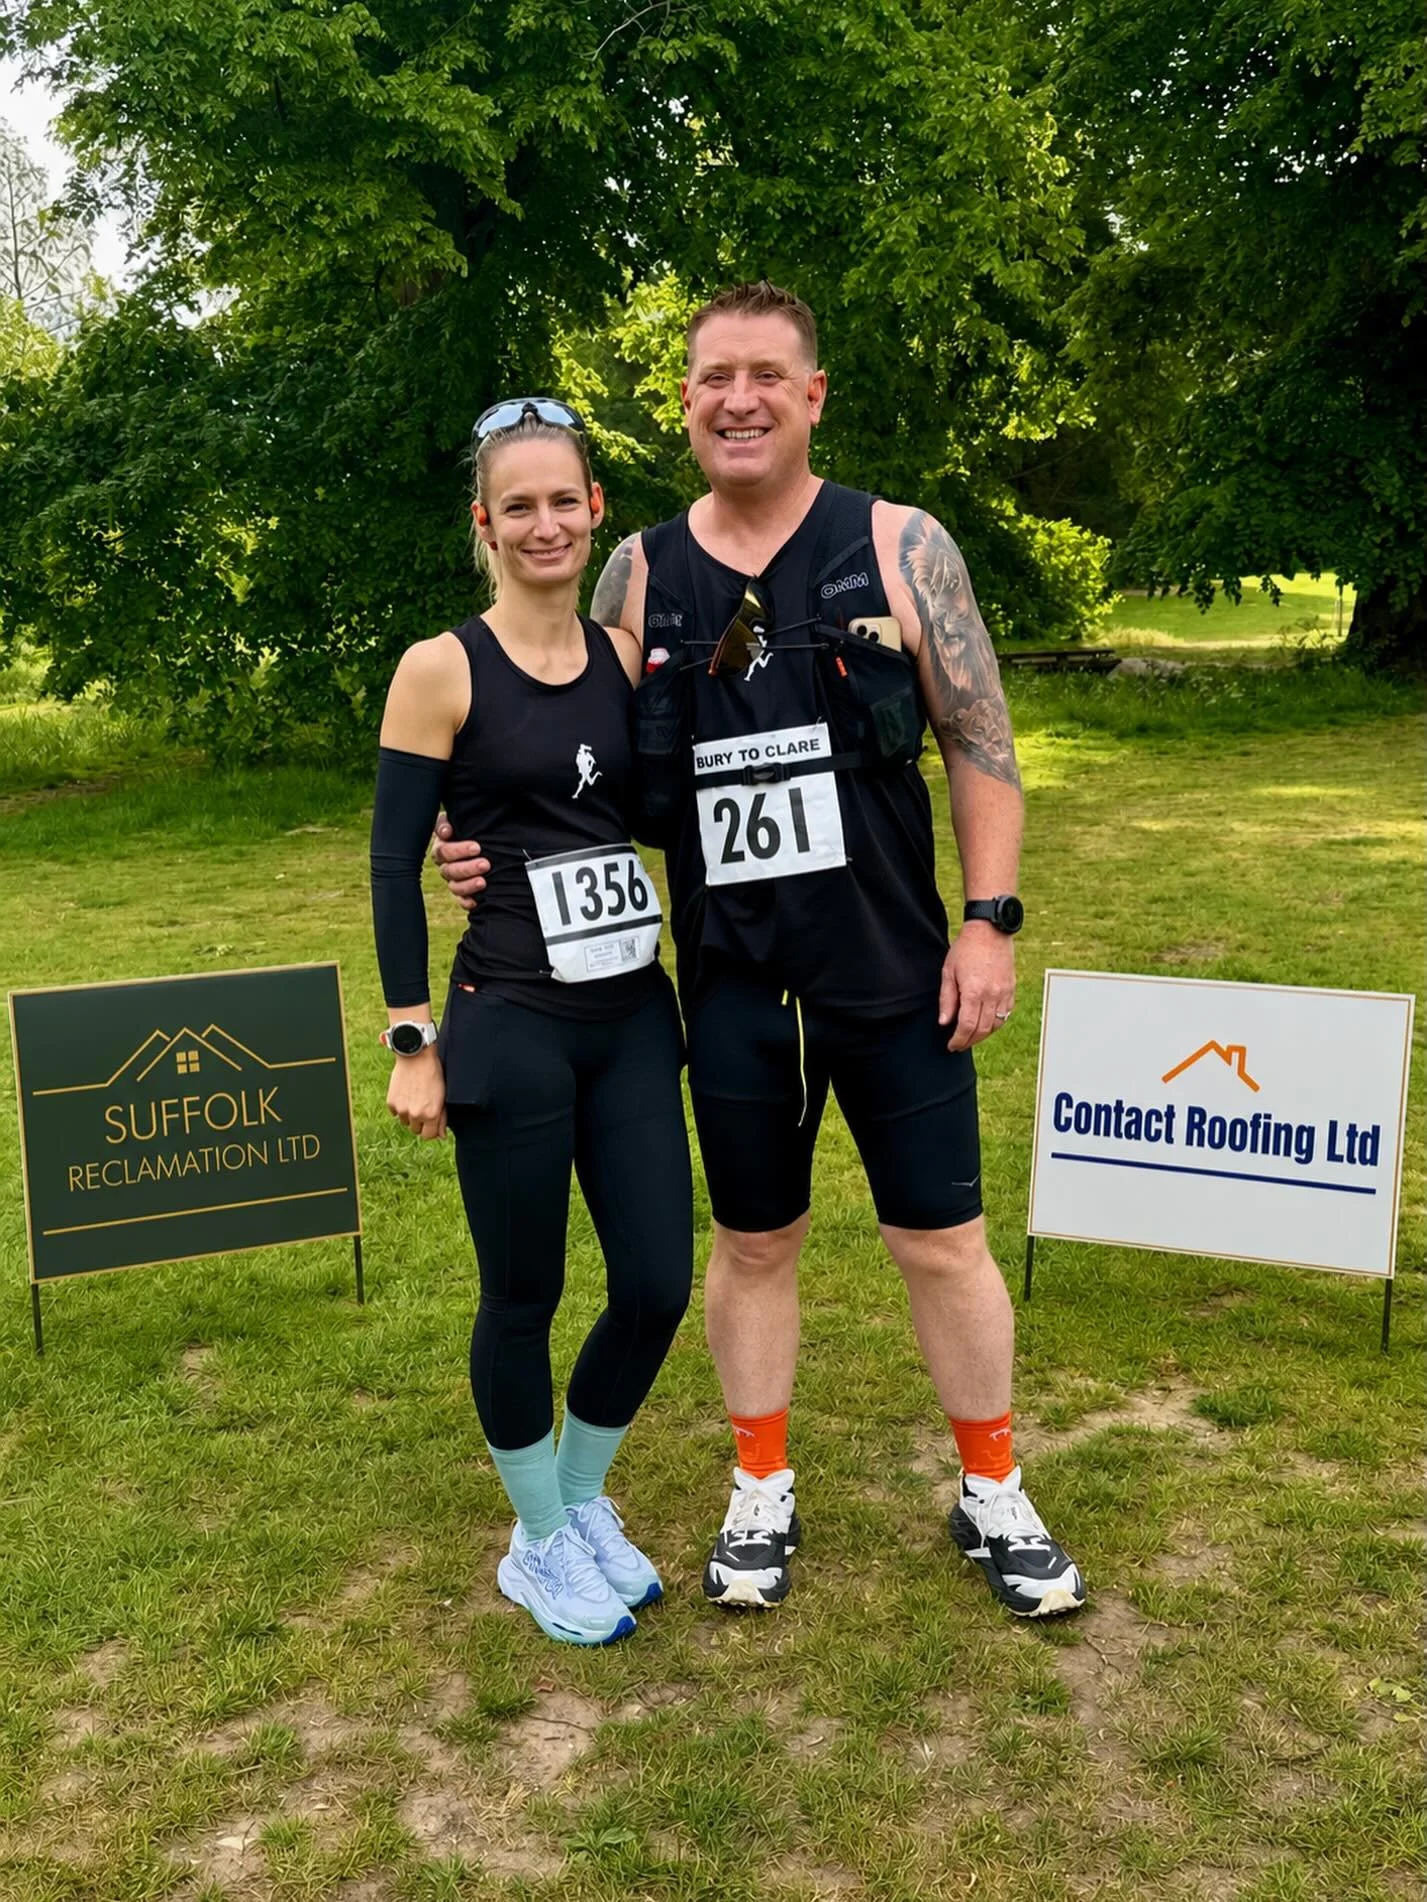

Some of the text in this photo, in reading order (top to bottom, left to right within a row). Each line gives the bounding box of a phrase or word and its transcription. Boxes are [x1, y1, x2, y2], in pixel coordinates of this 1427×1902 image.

[696, 738, 821, 769] BURY TO CLARE
[713, 787, 811, 864] 261
[551, 859, 649, 926] 1356
[104, 1086, 283, 1145] SUFFOLK
[1053, 1091, 1381, 1167] Contact Roofing Ltd
[68, 1134, 321, 1192] RECLAMATION LTD
